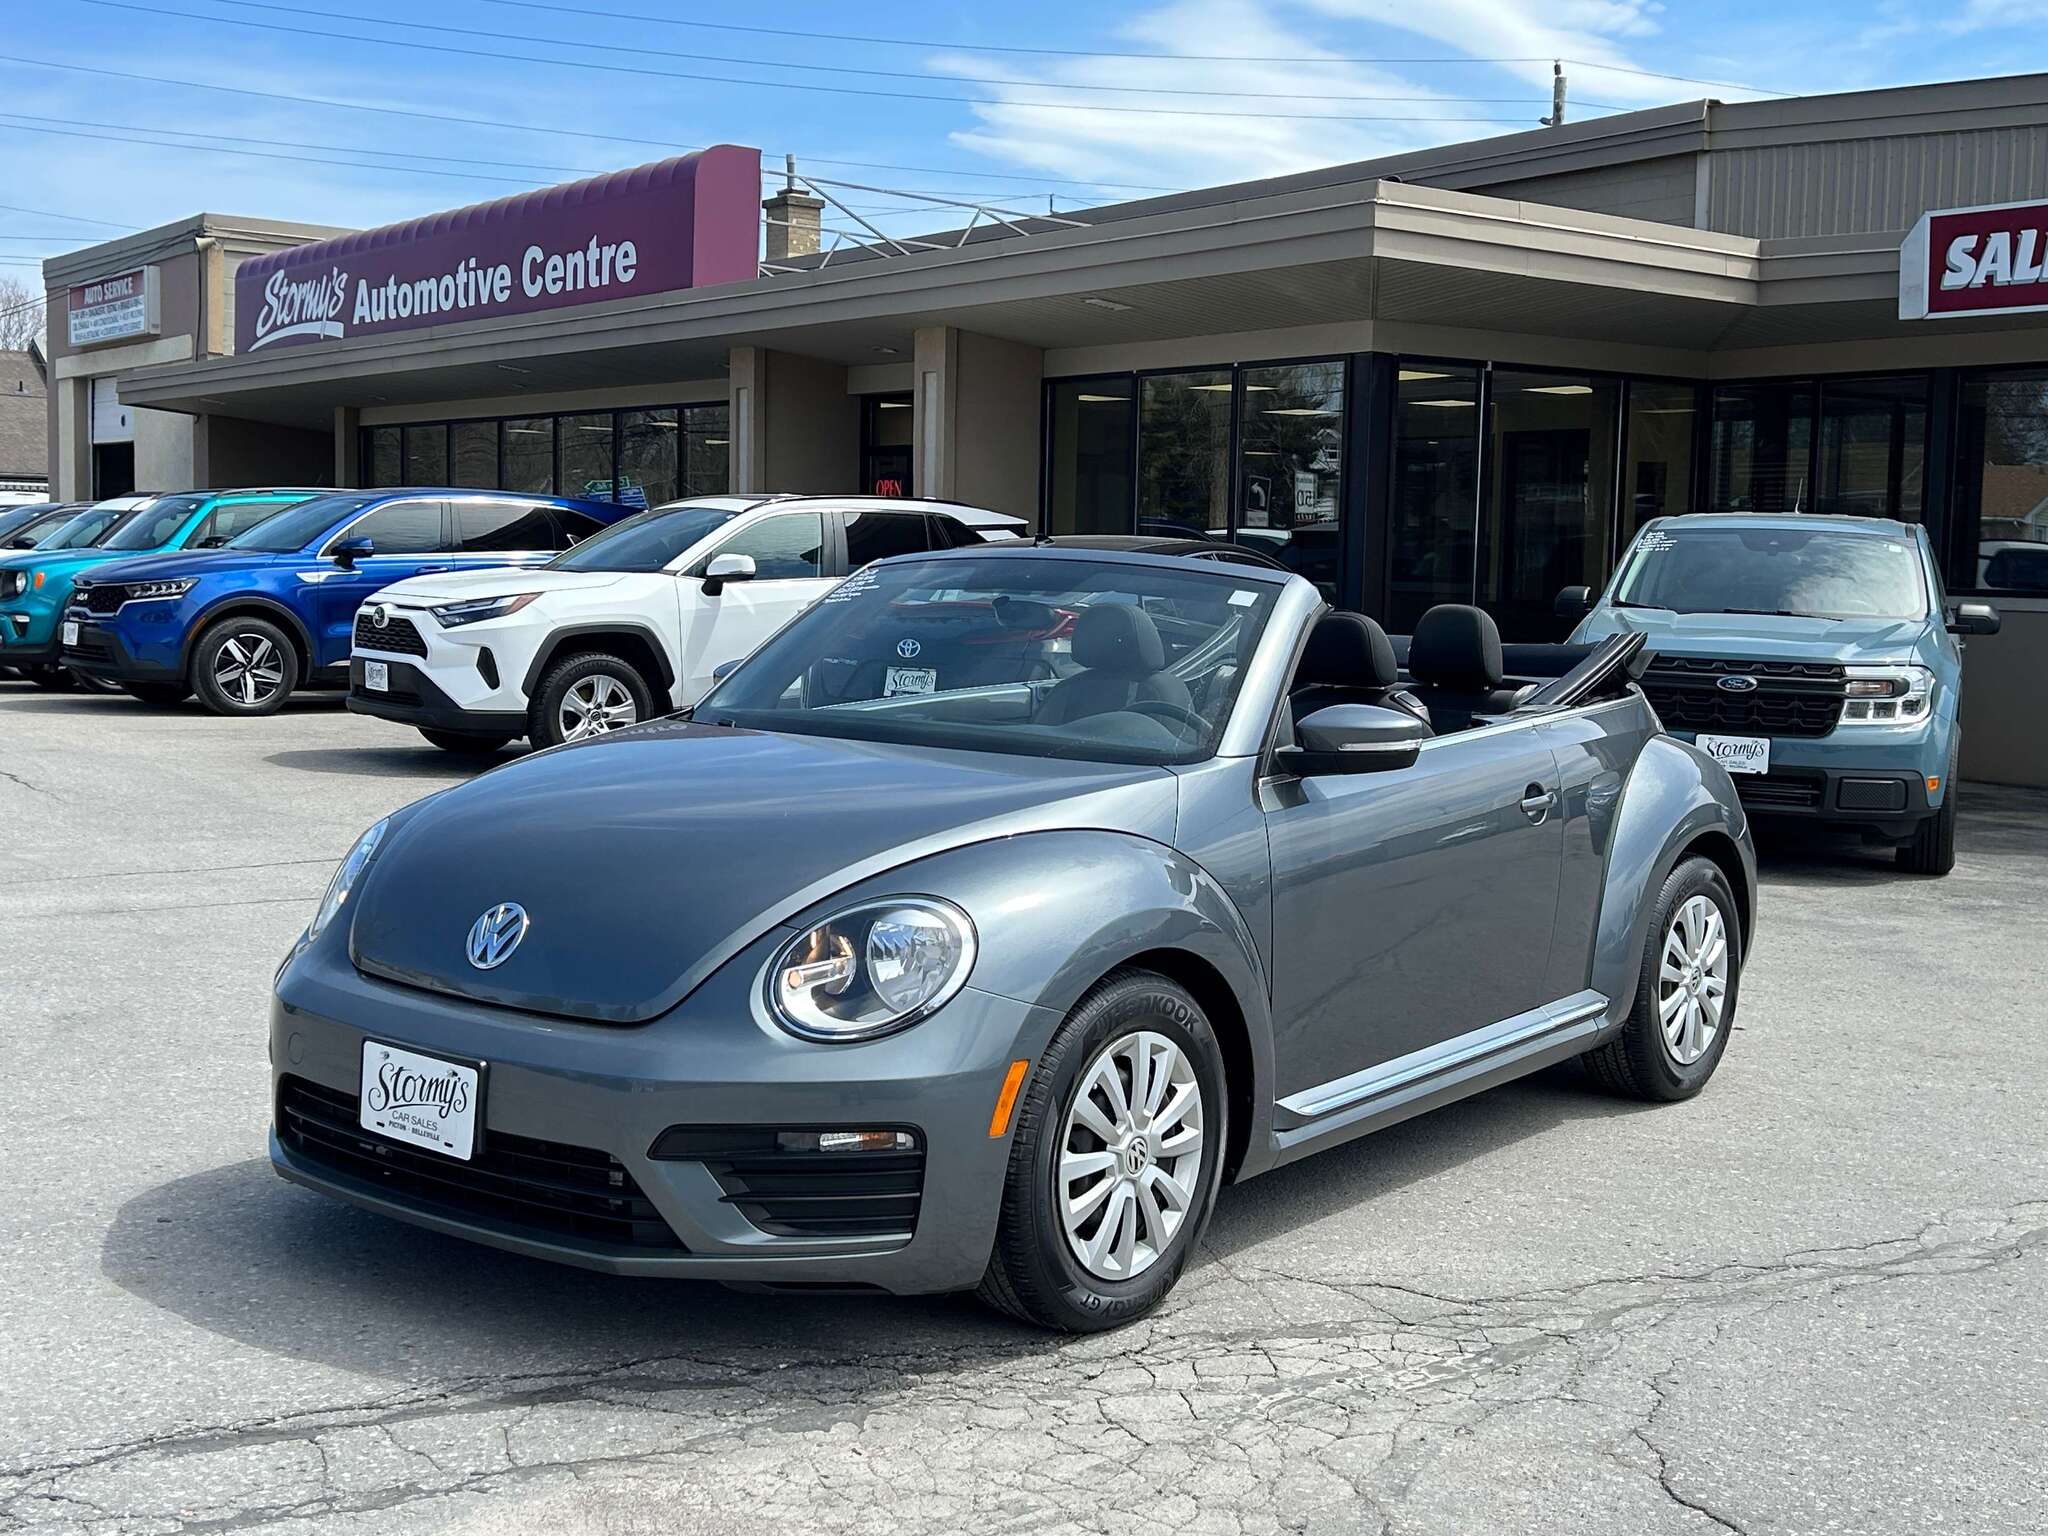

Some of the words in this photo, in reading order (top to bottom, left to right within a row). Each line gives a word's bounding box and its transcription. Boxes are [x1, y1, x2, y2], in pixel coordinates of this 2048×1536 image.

[1940, 228, 2048, 291] SAL
[84, 285, 103, 304] AUTO
[103, 276, 133, 301] SERVICE
[255, 267, 350, 340] Stormy's
[352, 257, 511, 325] Automotive
[521, 234, 637, 298] Centre
[876, 480, 901, 496] OPEN
[1706, 740, 1766, 760] Stormy's
[368, 1063, 469, 1119] Stormy's
[391, 1110, 410, 1123] CAR
[411, 1115, 438, 1132] SALES
